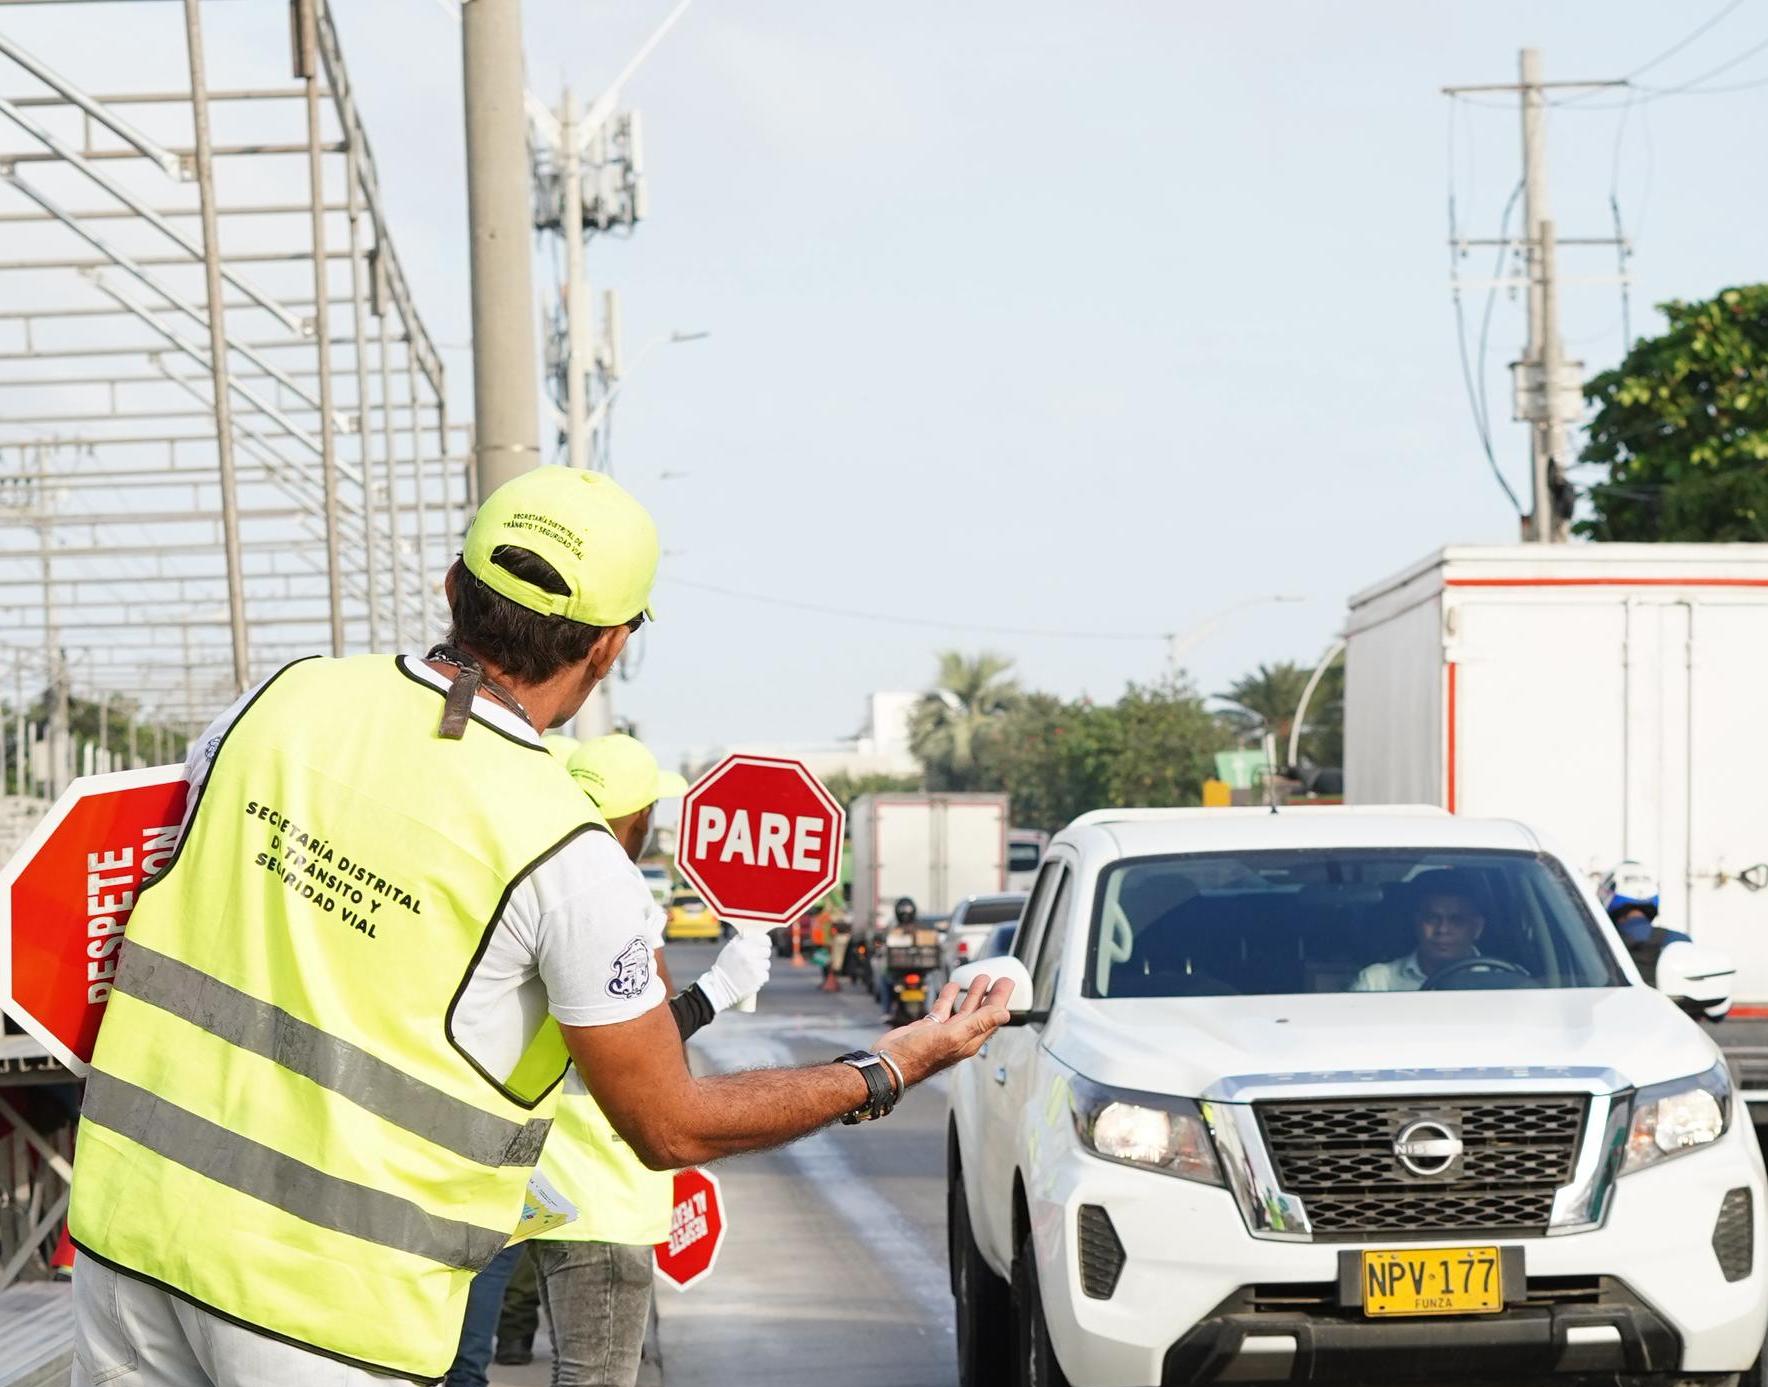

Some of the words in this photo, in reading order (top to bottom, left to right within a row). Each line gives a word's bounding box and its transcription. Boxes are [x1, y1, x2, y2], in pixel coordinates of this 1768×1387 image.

[538, 526, 571, 548] SEGURIDAD
[571, 546, 584, 560] VIAL
[695, 805, 825, 873] PARE
[284, 847, 363, 904] TRÁNSITO
[370, 900, 382, 914] Y
[338, 857, 421, 915] DISTRITAL
[341, 908, 376, 939] VIAL
[1368, 1261, 1425, 1297] NPV
[1440, 1258, 1496, 1295] 177
[1415, 1298, 1453, 1310] FUNZA
